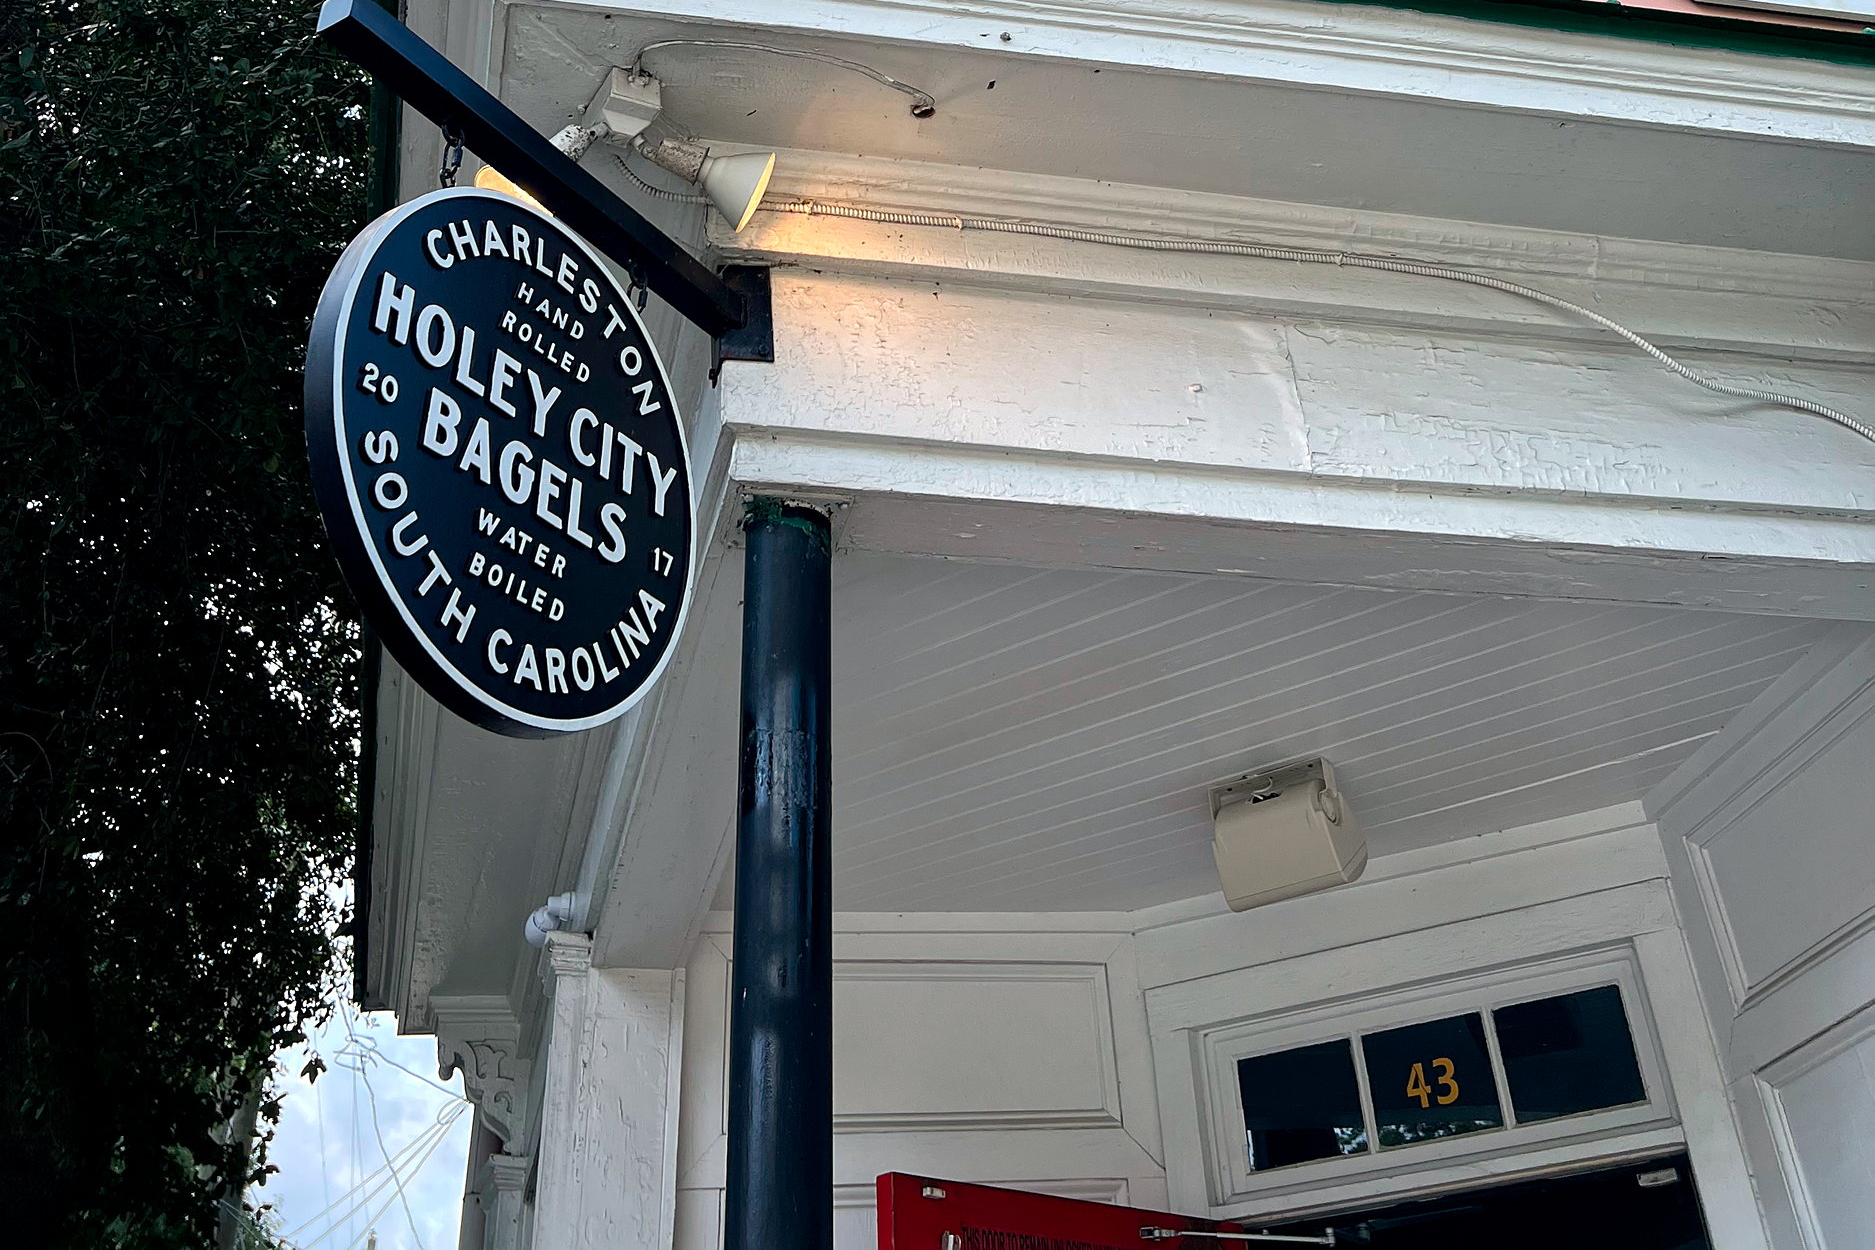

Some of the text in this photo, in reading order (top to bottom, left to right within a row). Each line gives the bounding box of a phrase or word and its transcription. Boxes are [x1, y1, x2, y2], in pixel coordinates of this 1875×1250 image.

[426, 219, 661, 416] CHARLESTON
[501, 310, 590, 383] ROLLED
[516, 281, 585, 341] HAND
[362, 362, 399, 403] 20
[374, 271, 678, 517] HOLEY CITY
[423, 386, 627, 563] BAGELS
[364, 430, 666, 694] SOUTH CAROLINA
[478, 507, 567, 579] WATER
[653, 547, 674, 577] 17
[468, 551, 565, 622] BOILED
[1405, 1056, 1460, 1109] 43
[961, 1226, 980, 1250] THIS
